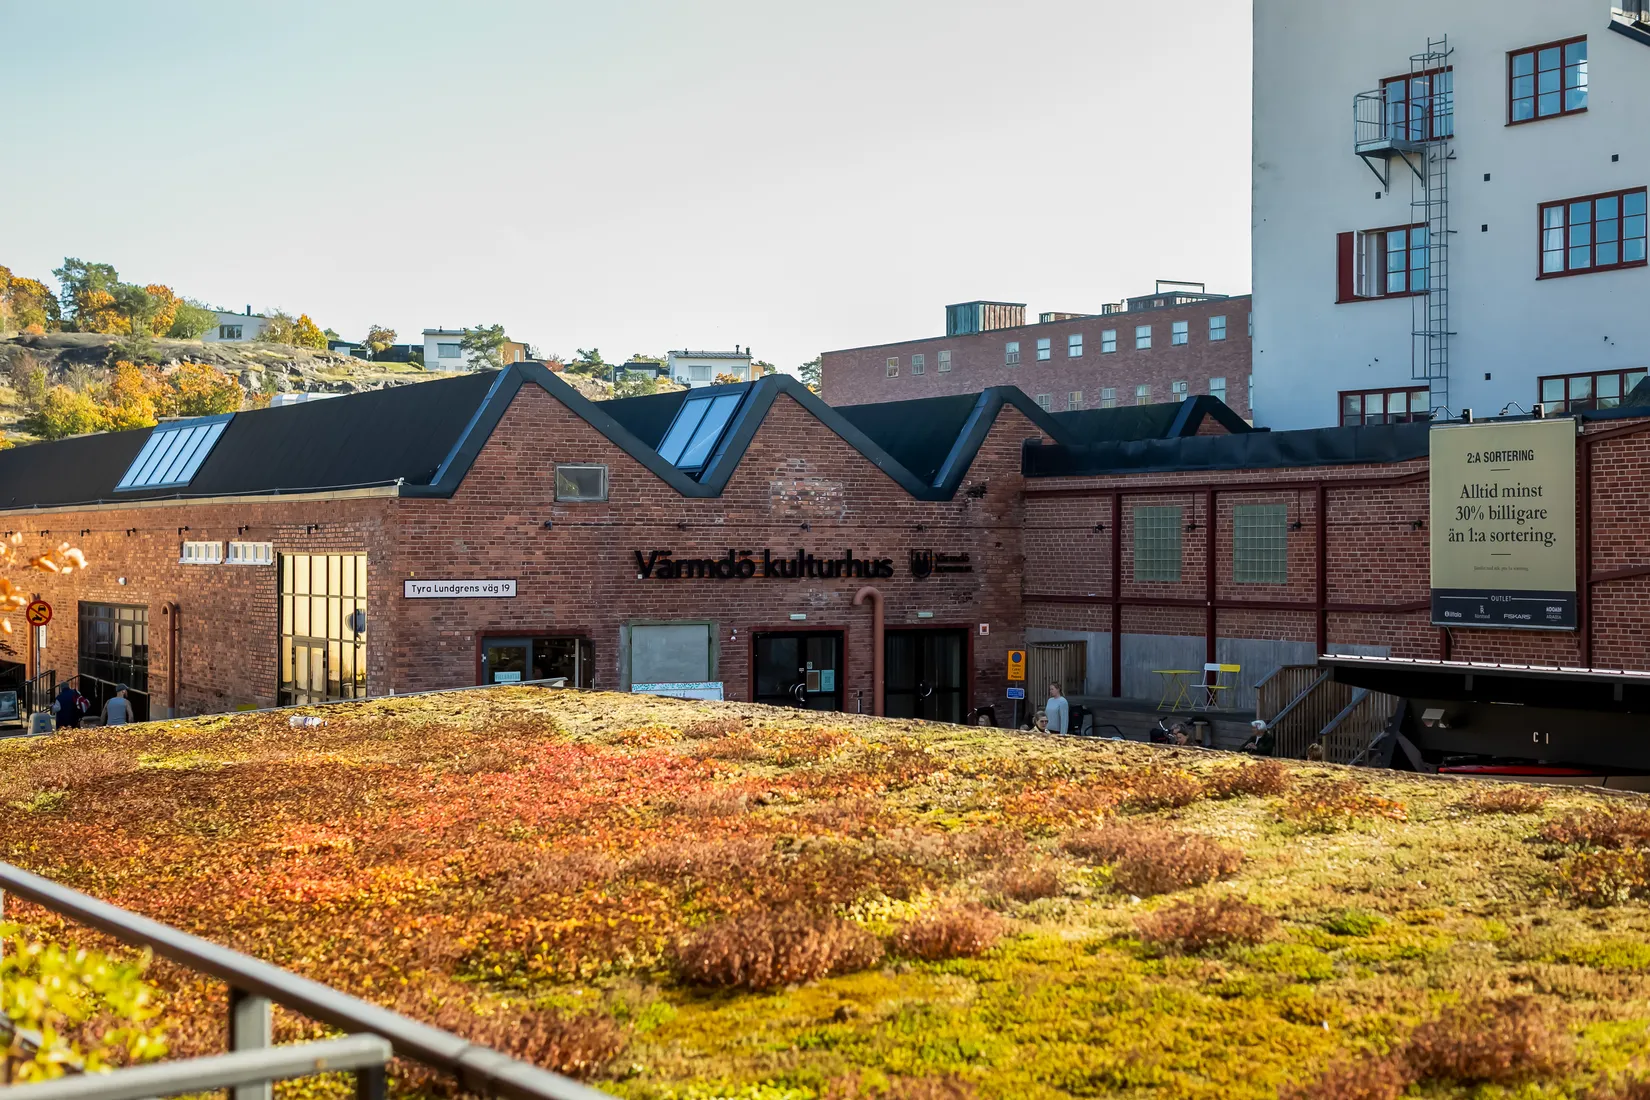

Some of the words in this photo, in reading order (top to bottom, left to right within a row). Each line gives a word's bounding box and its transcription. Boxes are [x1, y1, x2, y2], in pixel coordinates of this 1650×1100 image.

[1466, 452, 1481, 464] 2:A
[1483, 449, 1534, 463] SORTERING
[1460, 483, 1498, 499] Alltid
[1501, 482, 1543, 498] minst
[1455, 504, 1484, 521] 30%
[1488, 504, 1548, 526] billigare
[1448, 527, 1465, 542] än
[1467, 526, 1486, 542] 1:a
[1489, 526, 1557, 548] sortering.
[634, 548, 756, 579] Värmdö
[763, 548, 895, 579] kulturhus
[411, 584, 432, 595] Tyra
[434, 584, 480, 595] Lundgrens
[482, 583, 499, 594] väg
[501, 583, 511, 592] 19
